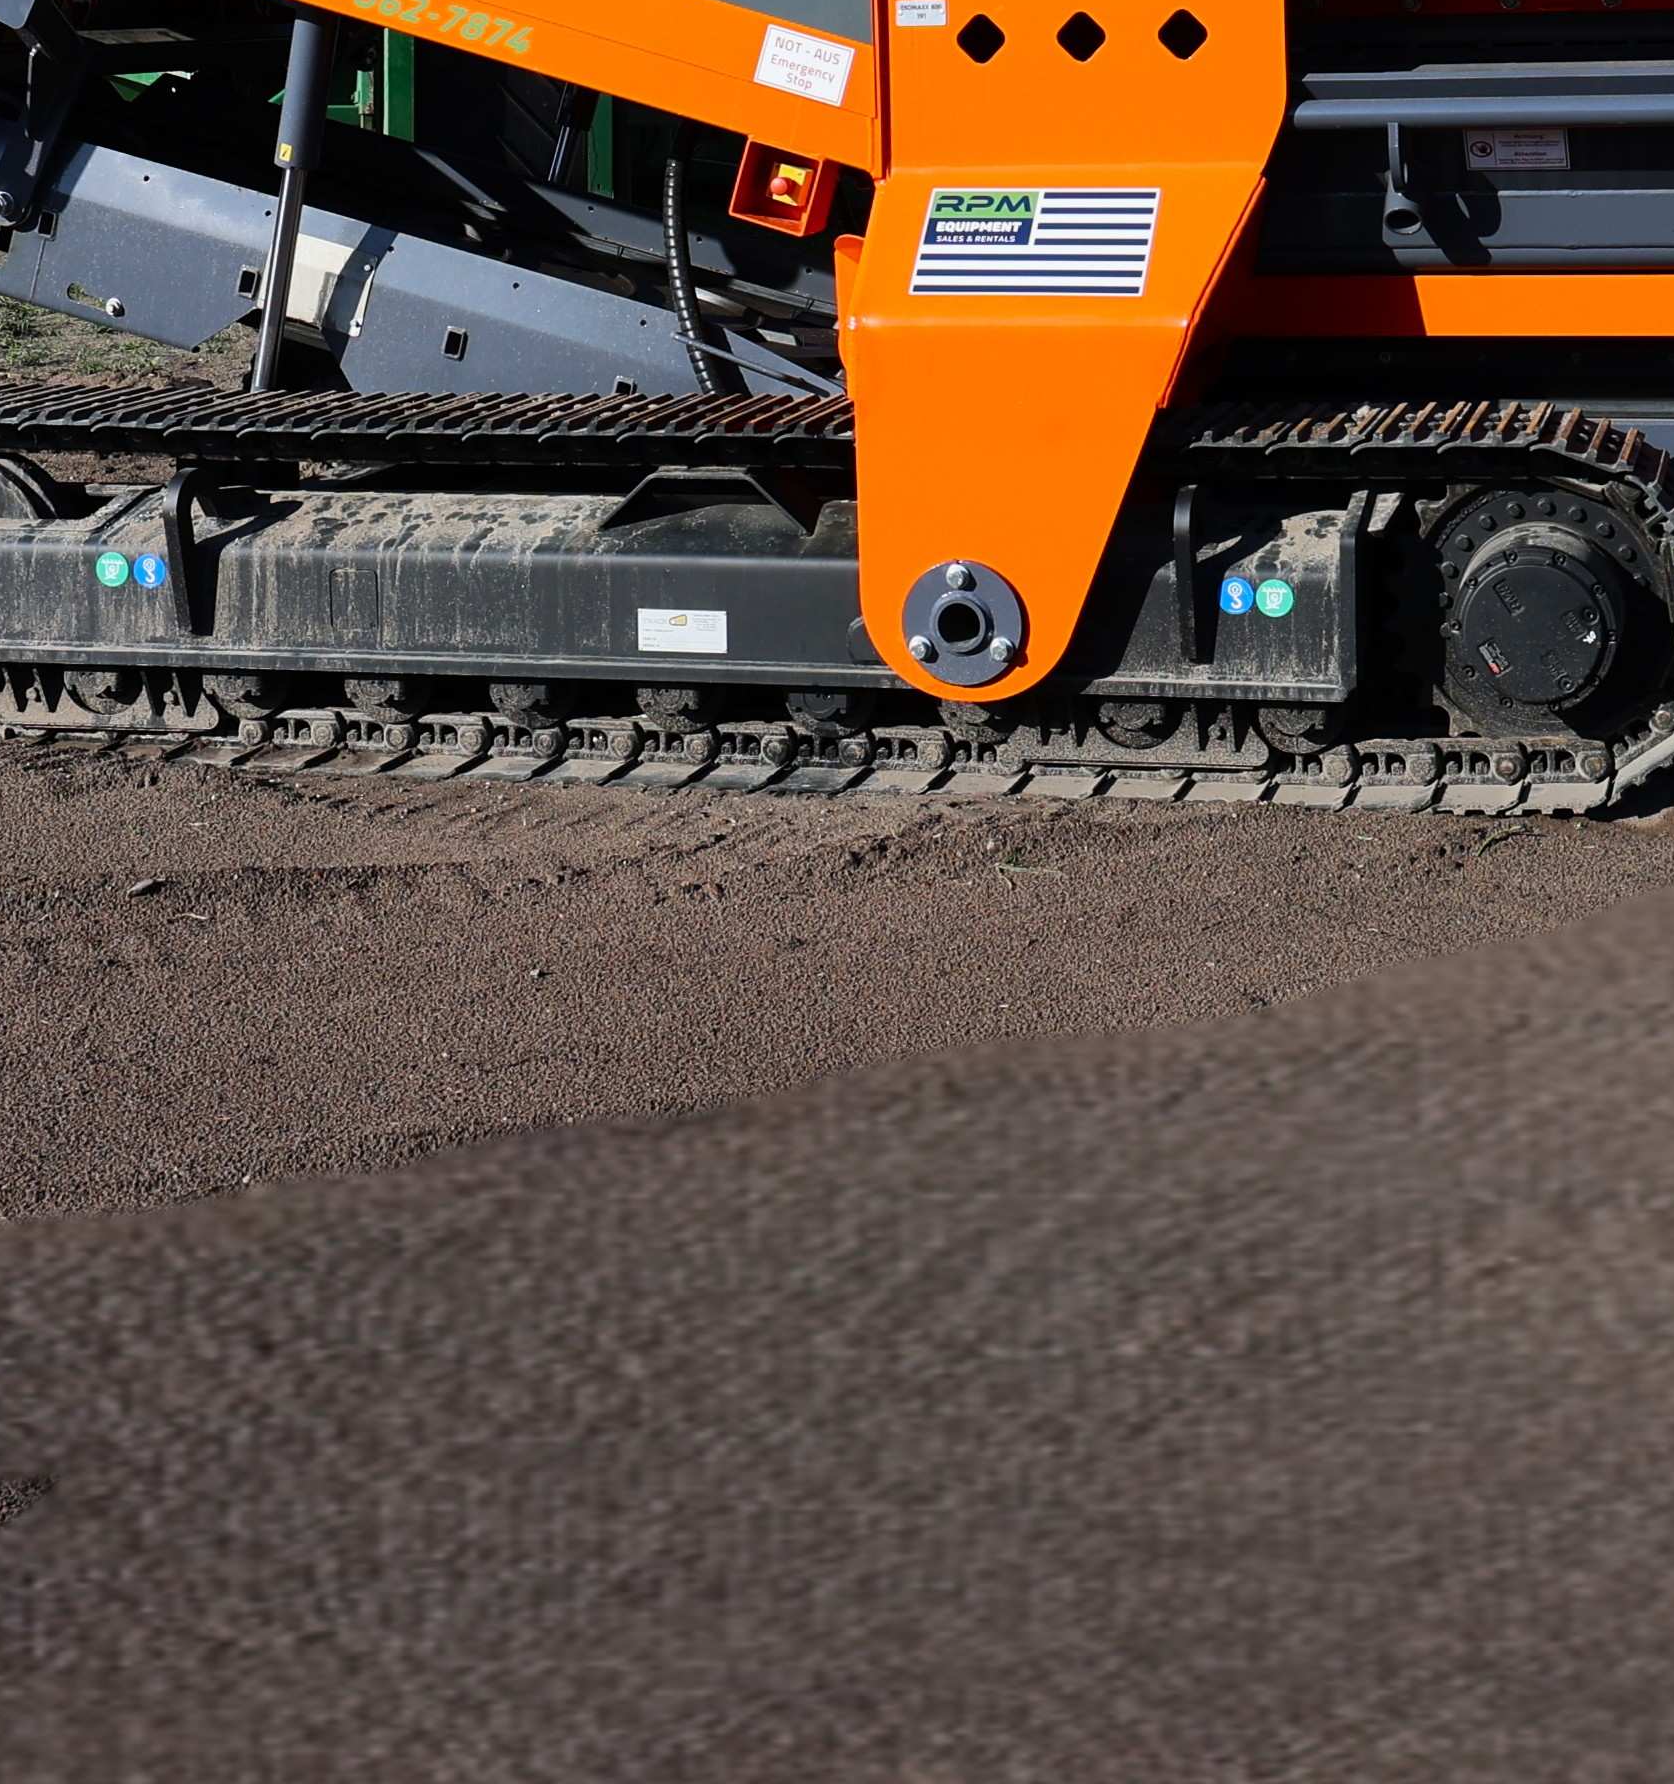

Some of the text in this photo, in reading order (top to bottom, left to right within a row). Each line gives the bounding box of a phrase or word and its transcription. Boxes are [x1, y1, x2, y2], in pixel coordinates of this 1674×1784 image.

[774, 36, 803, 54] NOT
[813, 48, 841, 65] AUS
[770, 53, 836, 83] Emergency
[785, 72, 813, 91] Stop
[934, 194, 1032, 213] RPM
[935, 221, 1023, 233] EQUIPMENT
[935, 235, 1016, 243] SALES & RENTALS
